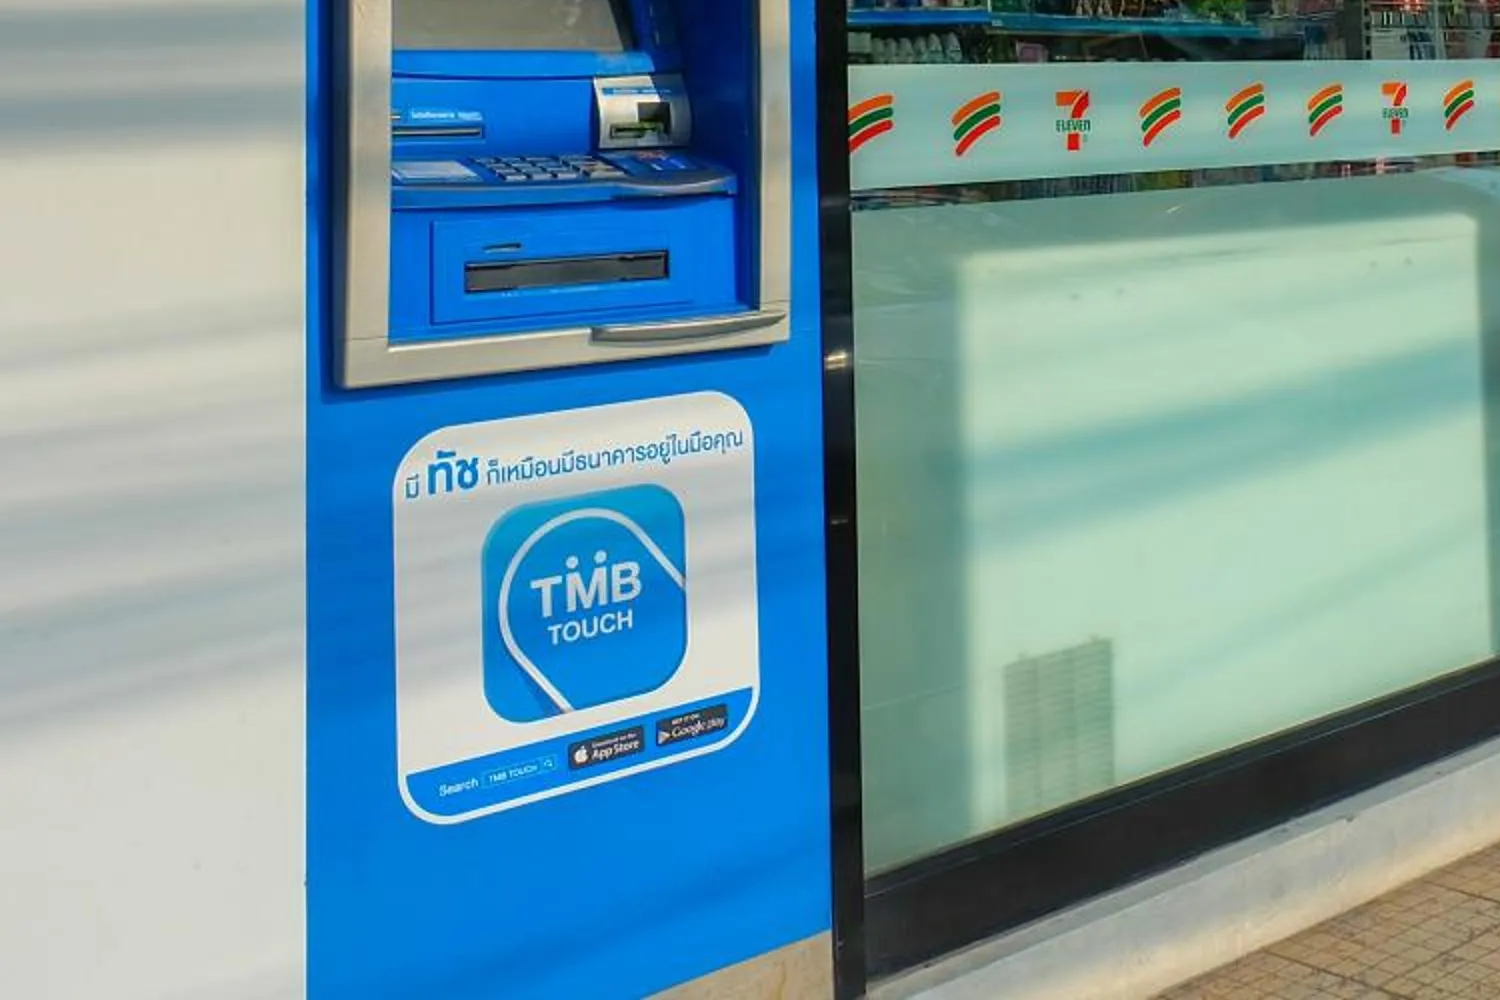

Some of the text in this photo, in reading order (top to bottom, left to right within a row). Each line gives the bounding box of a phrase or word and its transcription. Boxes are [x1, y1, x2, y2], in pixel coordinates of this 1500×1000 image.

[404, 429, 744, 499] มี ทัช ก็เหมือนมีธนาคารอยู่ในมือคุณ
[529, 549, 642, 619] TMB
[546, 608, 634, 646] TOUCH
[671, 721, 706, 738] Google
[591, 739, 640, 761] App Store
[439, 777, 479, 797] Search
